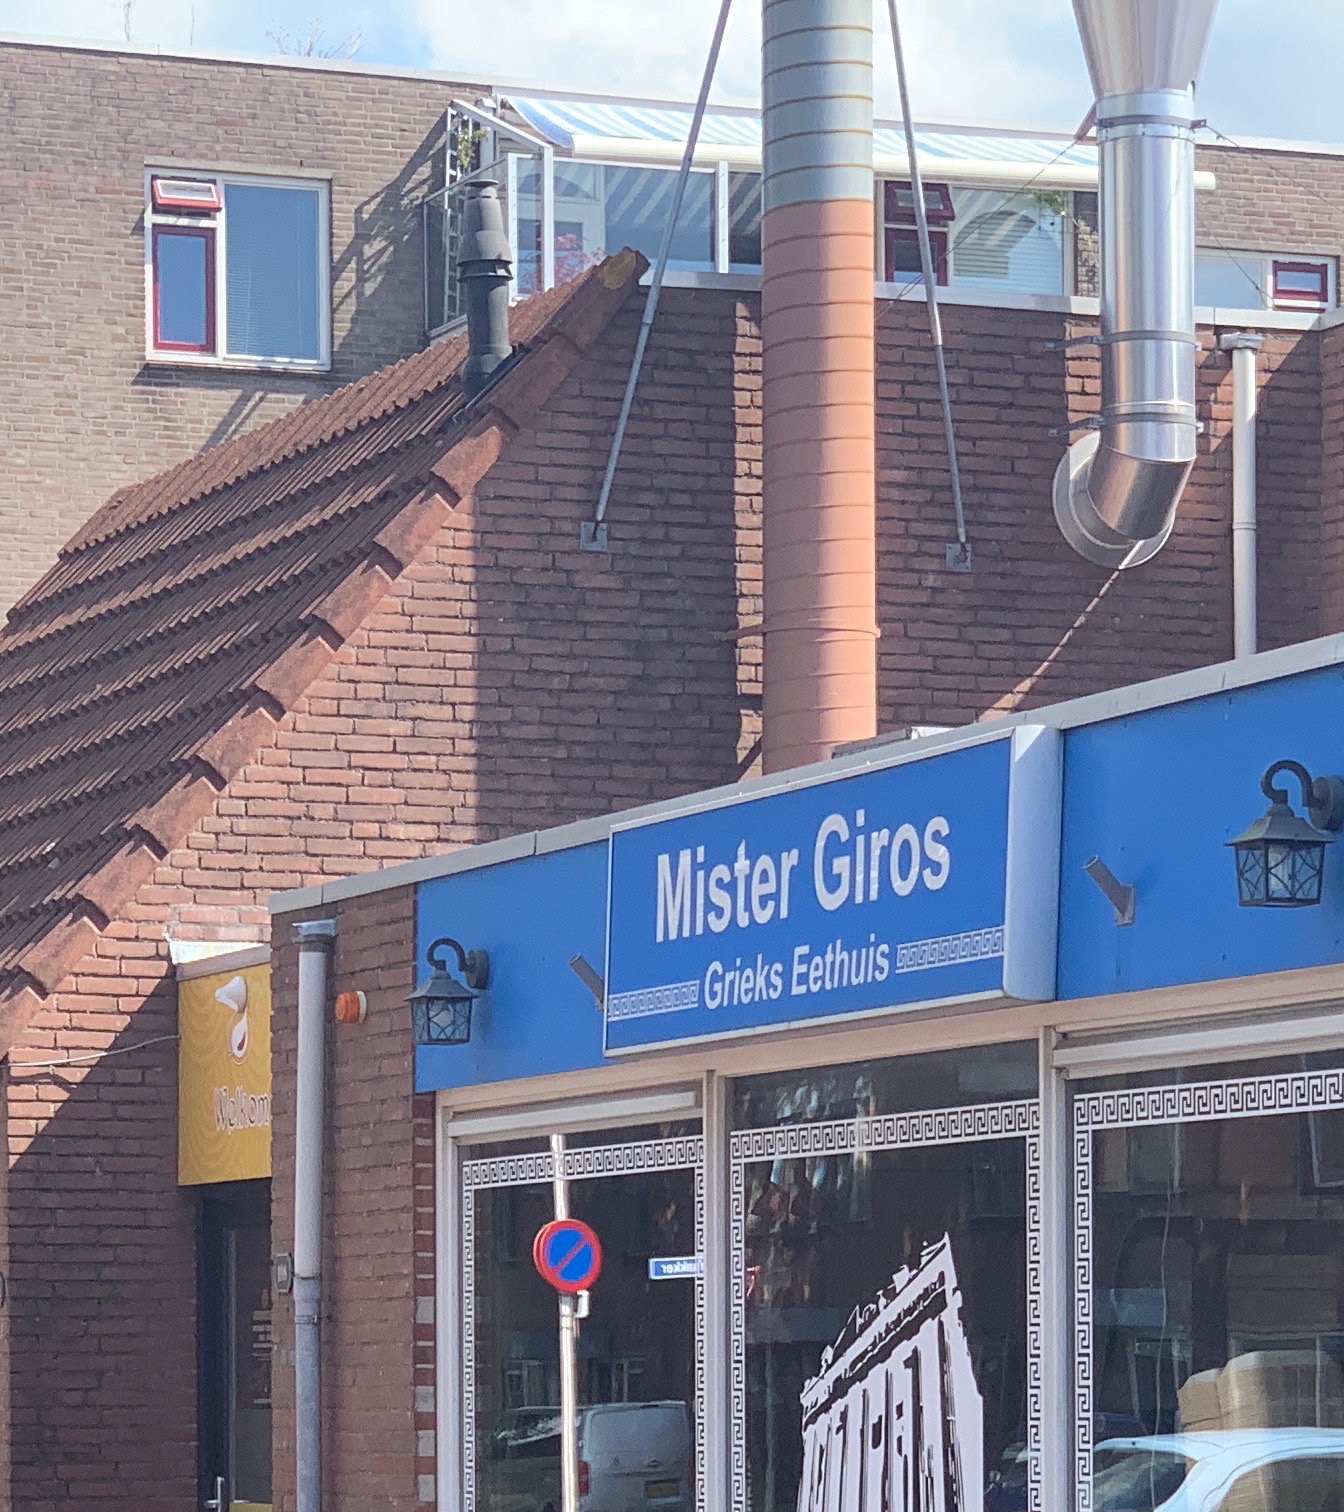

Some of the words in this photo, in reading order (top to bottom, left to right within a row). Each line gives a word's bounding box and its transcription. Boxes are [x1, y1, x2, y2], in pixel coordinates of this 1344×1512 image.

[656, 839, 799, 943] Mister
[814, 809, 950, 911] Giros
[705, 953, 783, 1010] Grieks
[791, 933, 889, 996] Eethuis
[214, 1085, 270, 1134] Welkom
